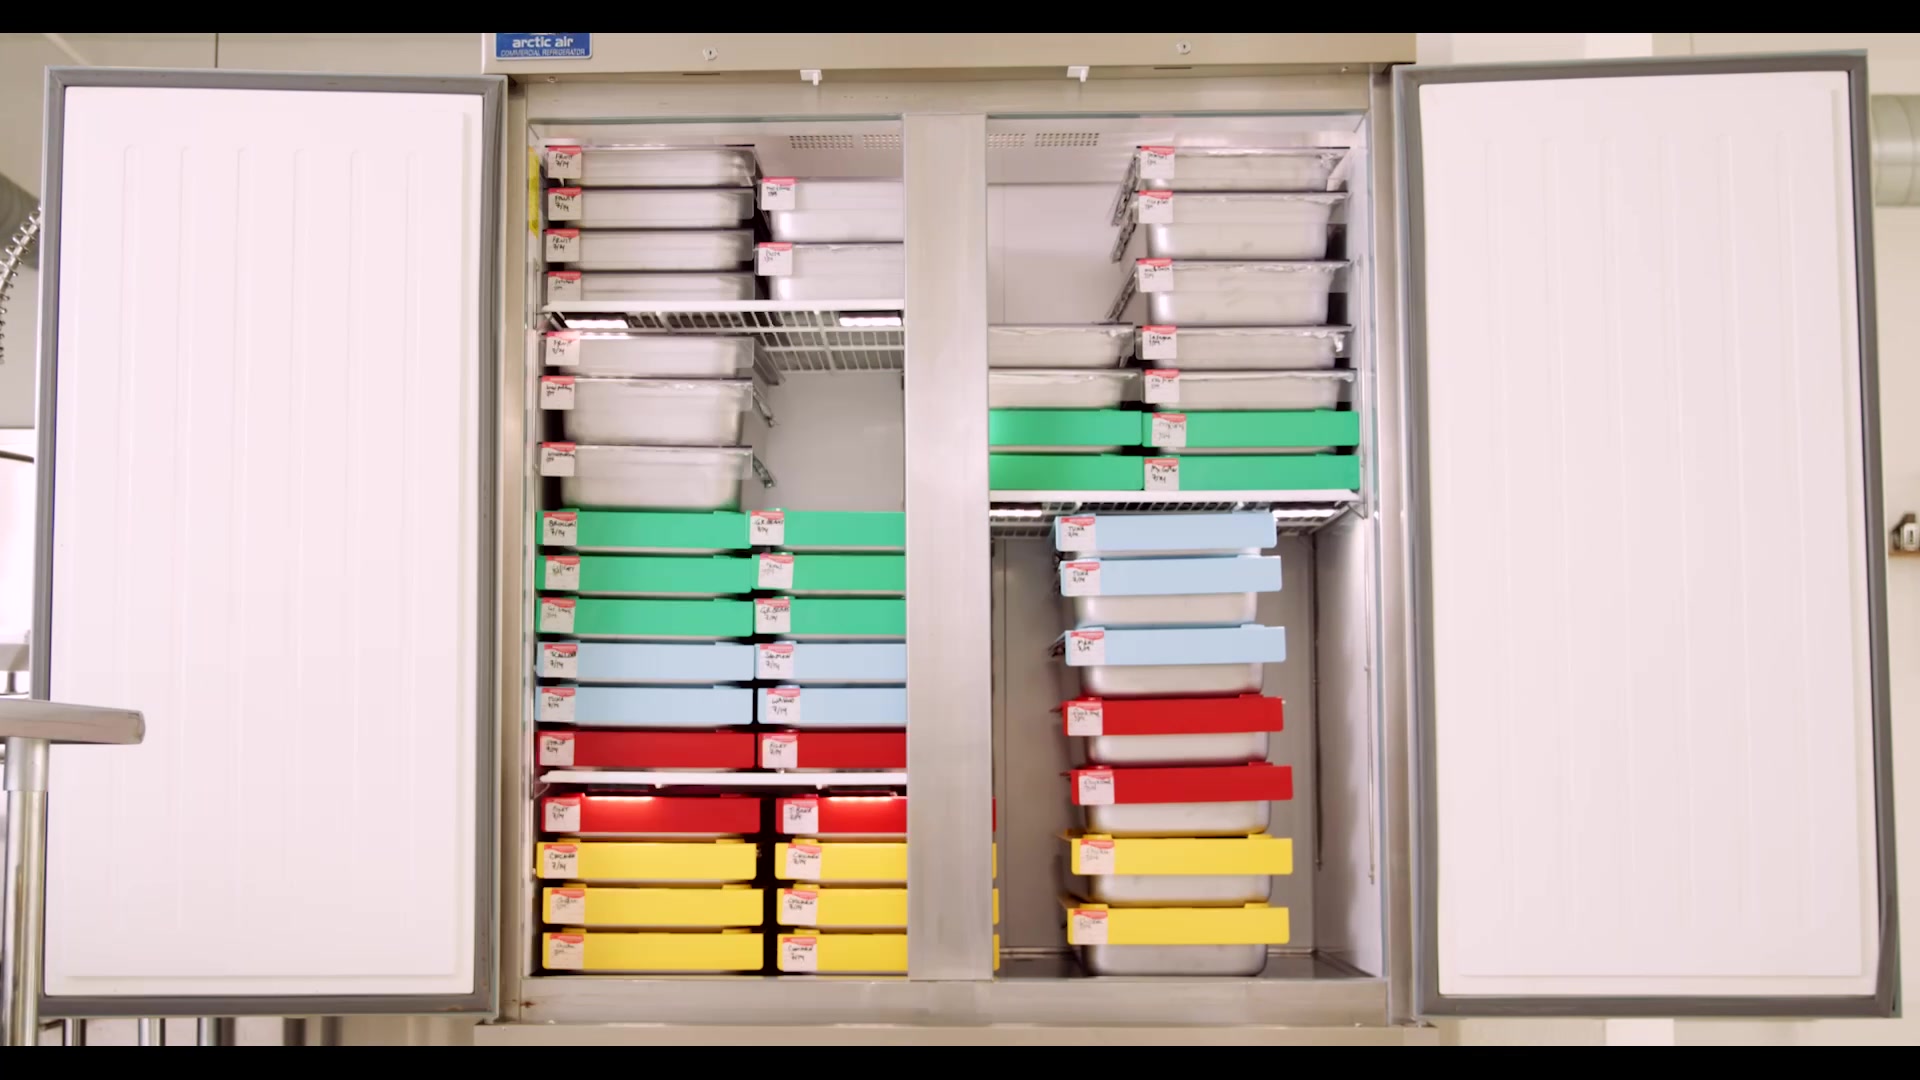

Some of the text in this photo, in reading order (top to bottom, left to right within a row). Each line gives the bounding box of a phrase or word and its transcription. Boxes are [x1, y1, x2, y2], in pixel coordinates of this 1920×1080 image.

[512, 36, 574, 48] arctic air
[501, 48, 585, 57] COMMERCIAL REFRIGERATOR
